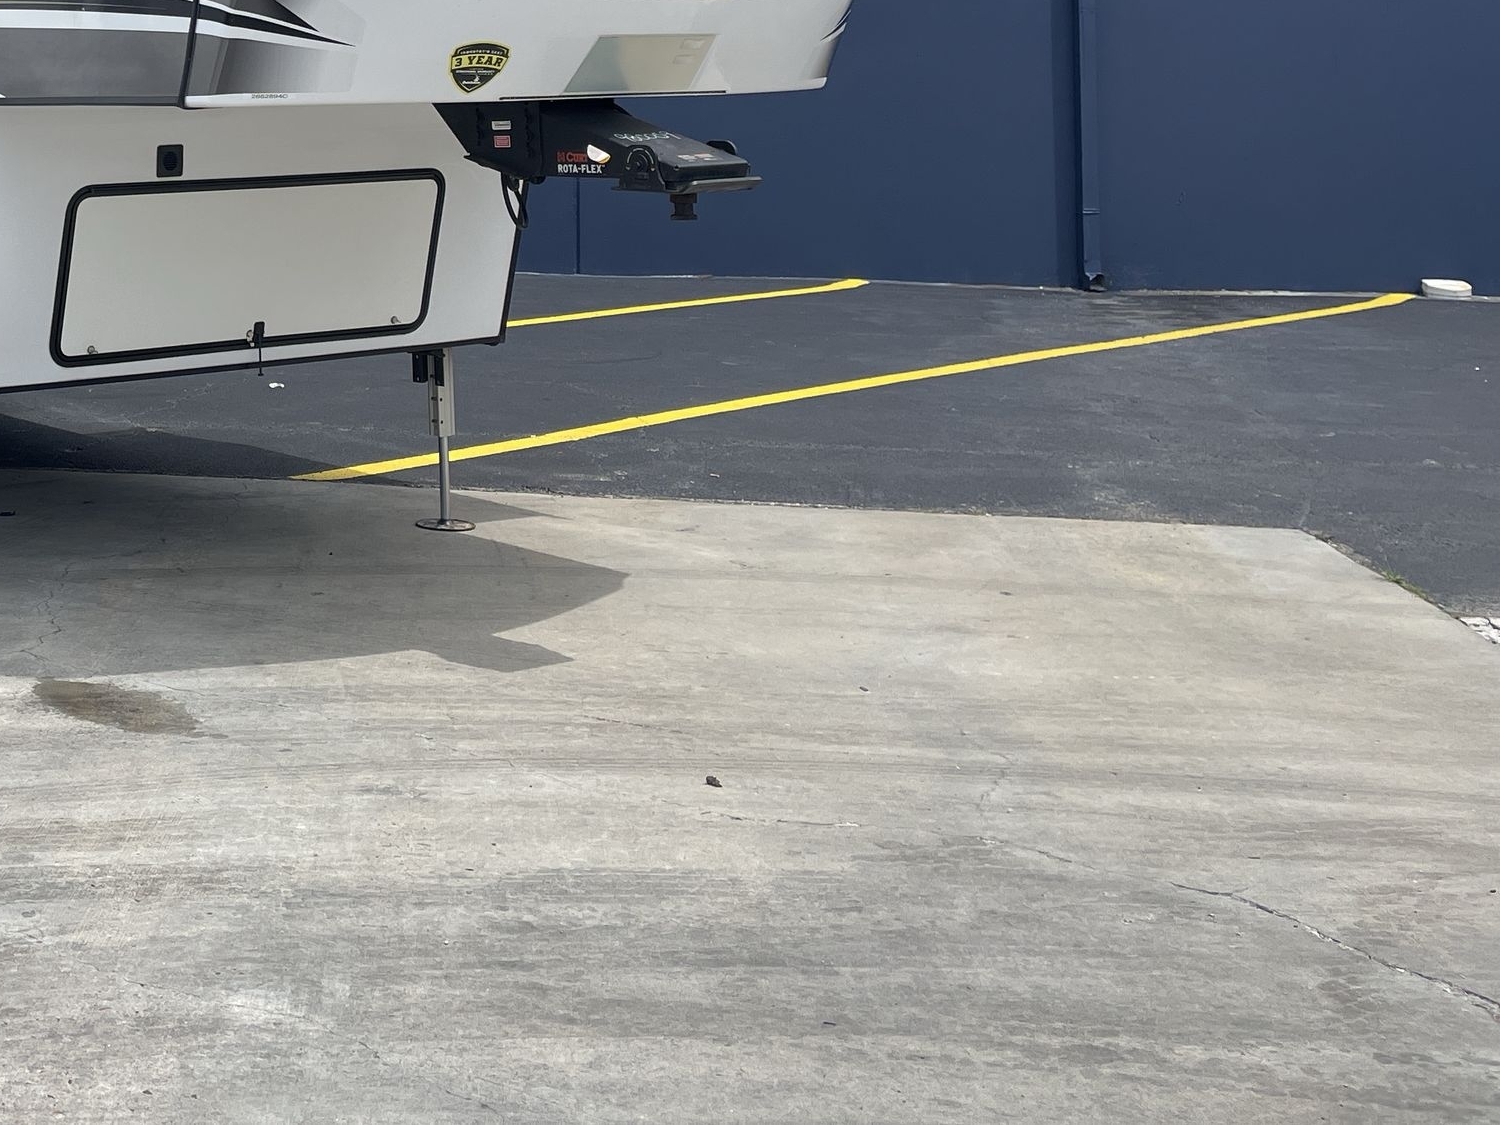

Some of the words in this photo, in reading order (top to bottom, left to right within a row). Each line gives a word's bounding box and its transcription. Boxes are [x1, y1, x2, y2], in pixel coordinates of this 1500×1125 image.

[454, 57, 463, 67] 3
[467, 55, 504, 67] YEAR
[557, 164, 603, 174] ROTA-FLEX
